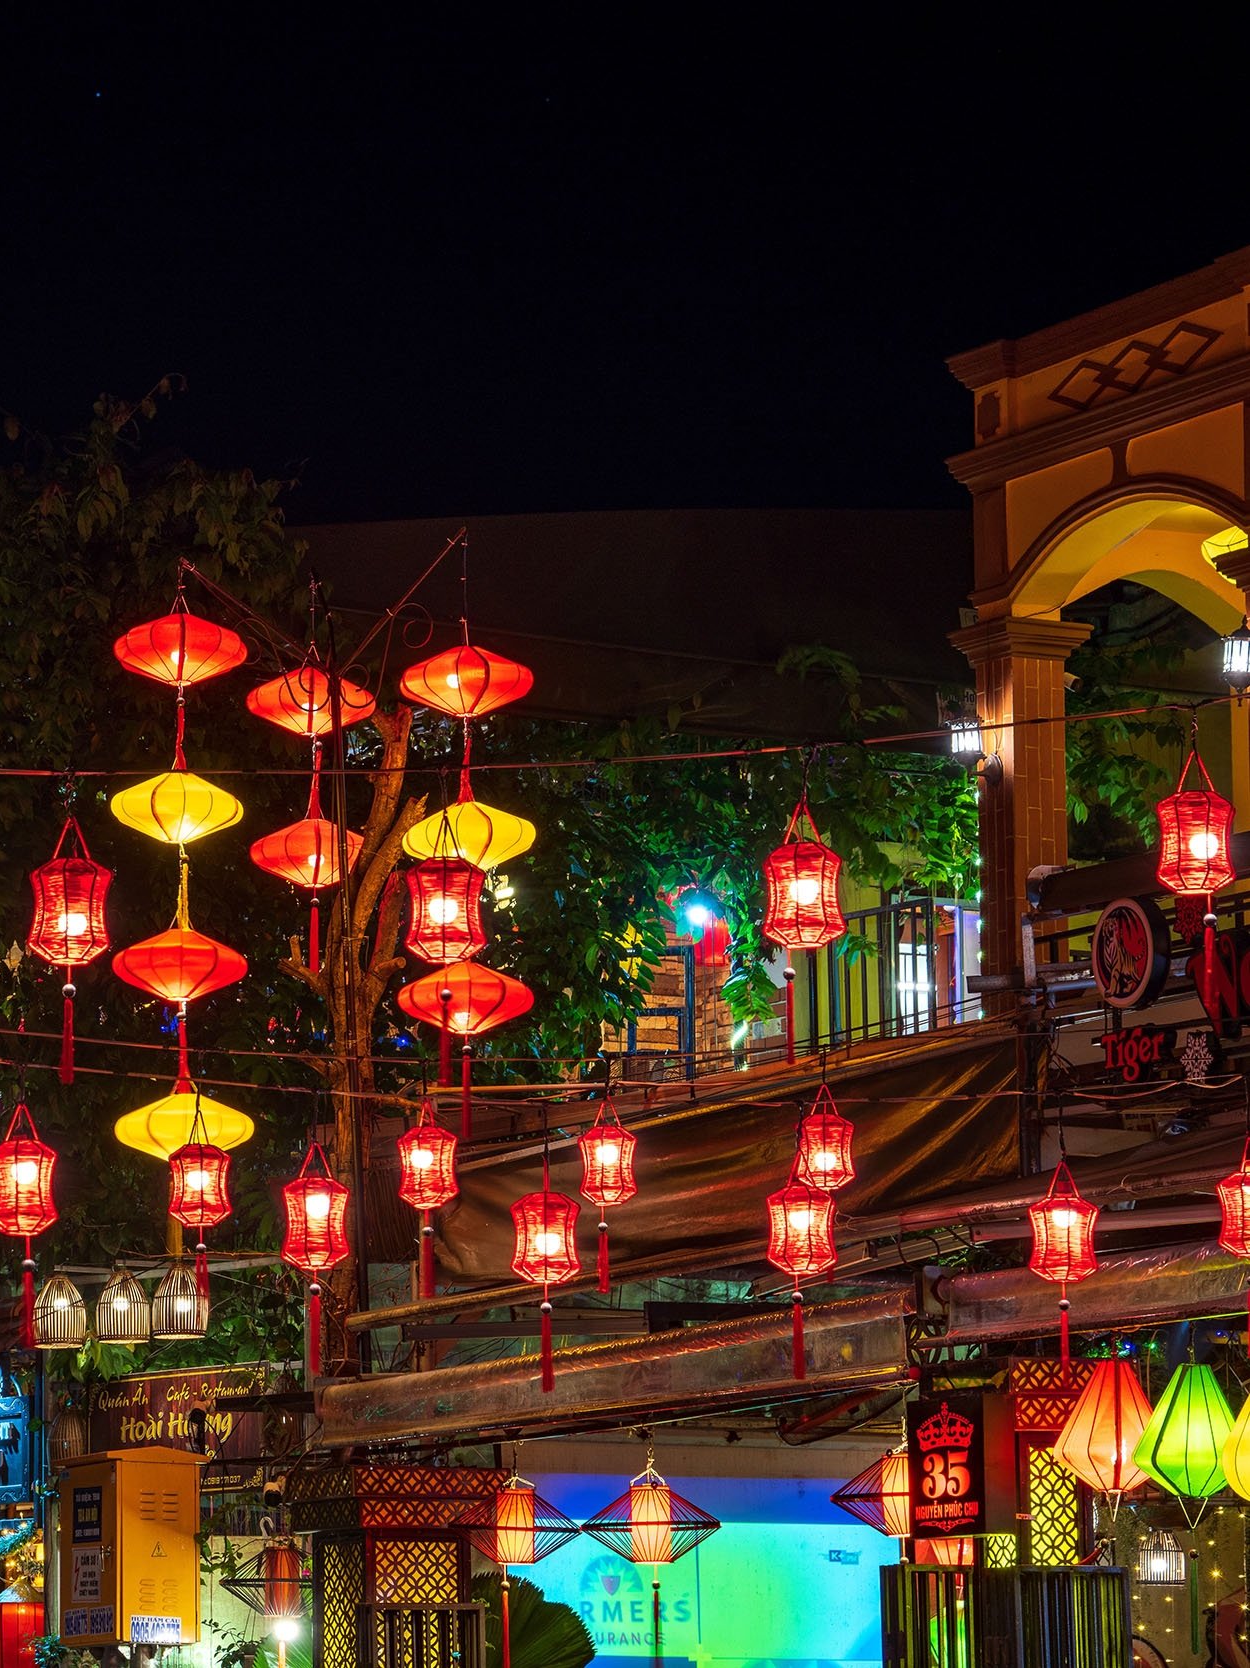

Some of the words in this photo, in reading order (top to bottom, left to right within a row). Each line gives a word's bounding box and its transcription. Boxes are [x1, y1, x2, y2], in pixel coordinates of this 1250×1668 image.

[1101, 1026, 1165, 1082] Tiger
[98, 1390, 129, 1412] Quán
[131, 1383, 149, 1406] Ăn
[166, 1382, 190, 1407] Café
[120, 1411, 164, 1444] Hoài
[168, 1411, 233, 1443] Hng
[922, 1450, 970, 1499] 35
[915, 1500, 943, 1520] NGUYỄN
[944, 1500, 963, 1518] PHÚC
[964, 1501, 979, 1516] CHU
[580, 1599, 691, 1623] RMERS
[595, 1632, 666, 1646] URANCE
